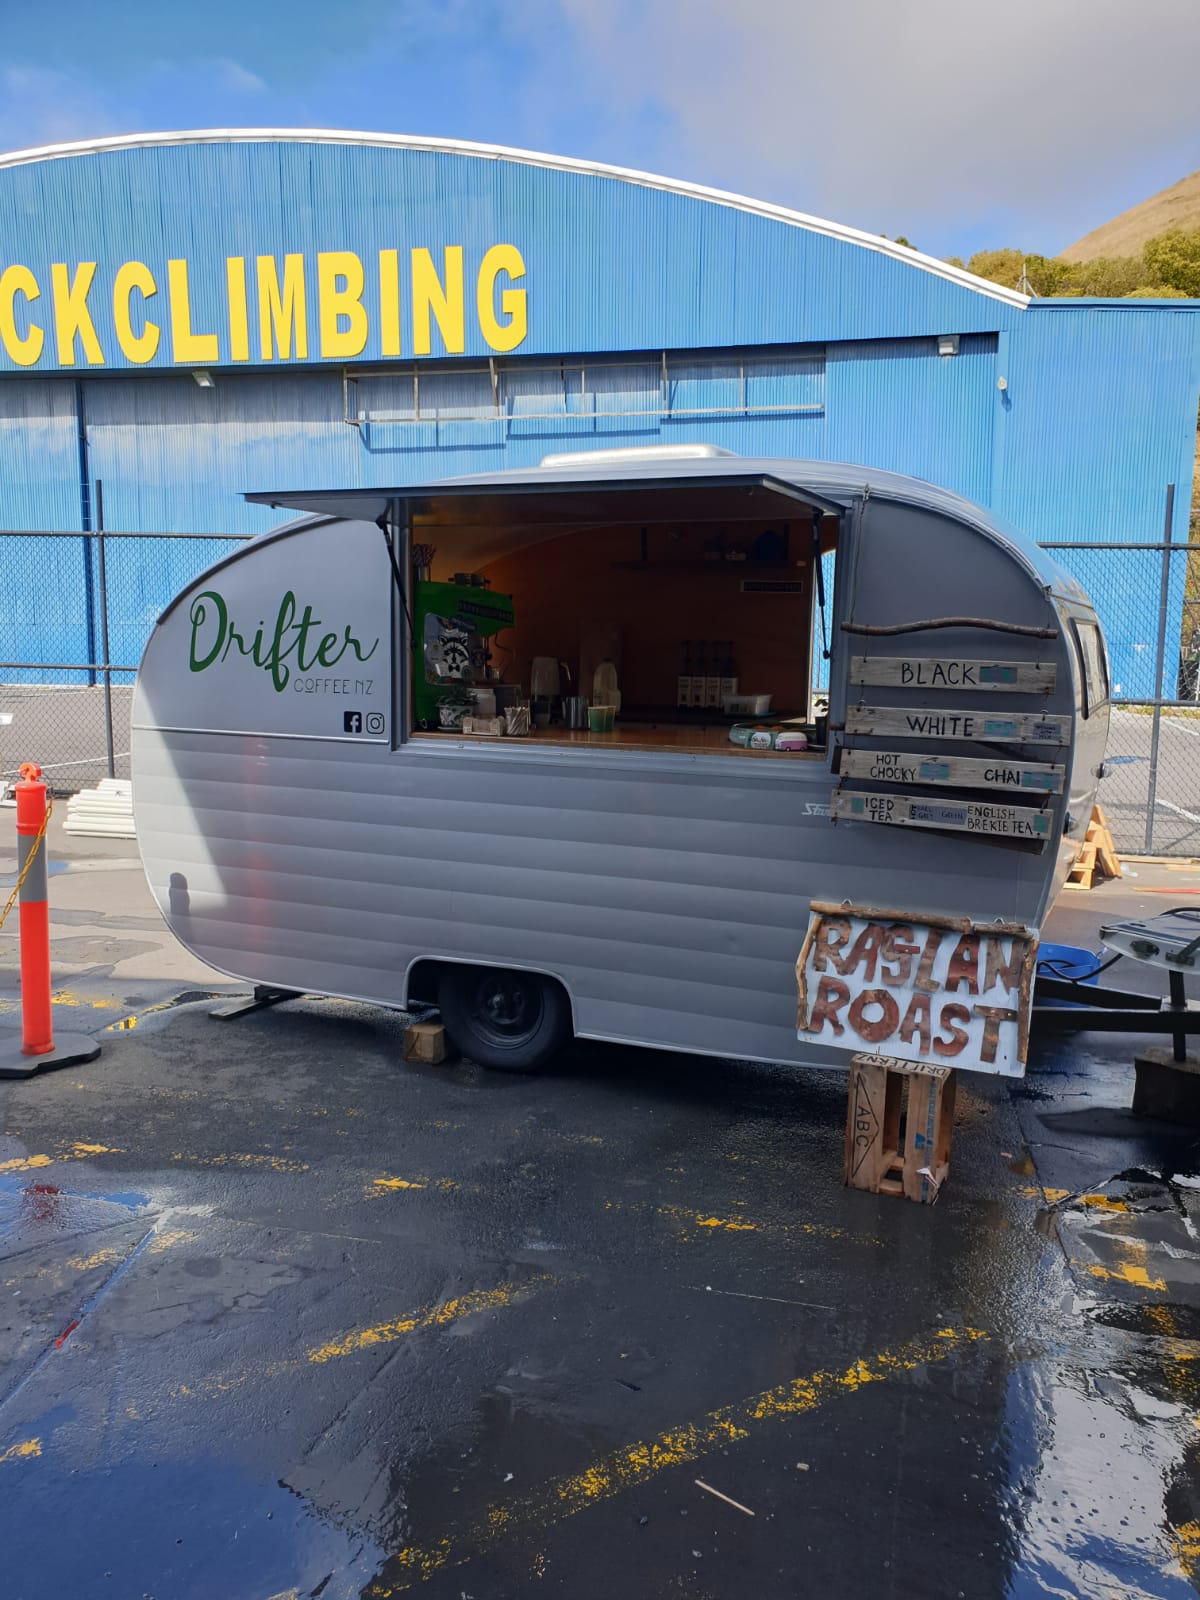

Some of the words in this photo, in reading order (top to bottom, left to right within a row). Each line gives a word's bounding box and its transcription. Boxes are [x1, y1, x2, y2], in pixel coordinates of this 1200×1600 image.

[190, 591, 380, 692] Drifter
[901, 662, 977, 685] BLACK
[294, 678, 350, 694] COFFEE
[355, 679, 373, 695] NZ
[906, 716, 974, 737] WHITE
[876, 754, 900, 766] HOT
[870, 766, 917, 782] CHOCKY
[984, 769, 1021, 785] CHAI
[865, 797, 894, 811] ICED
[967, 805, 1016, 819] ENGLISH
[869, 810, 893, 822] TEA
[1012, 820, 1034, 835] TEA
[813, 918, 1027, 995] RAGLAN
[807, 976, 1019, 1063] ROAST
[855, 1105, 871, 1148] ABC
